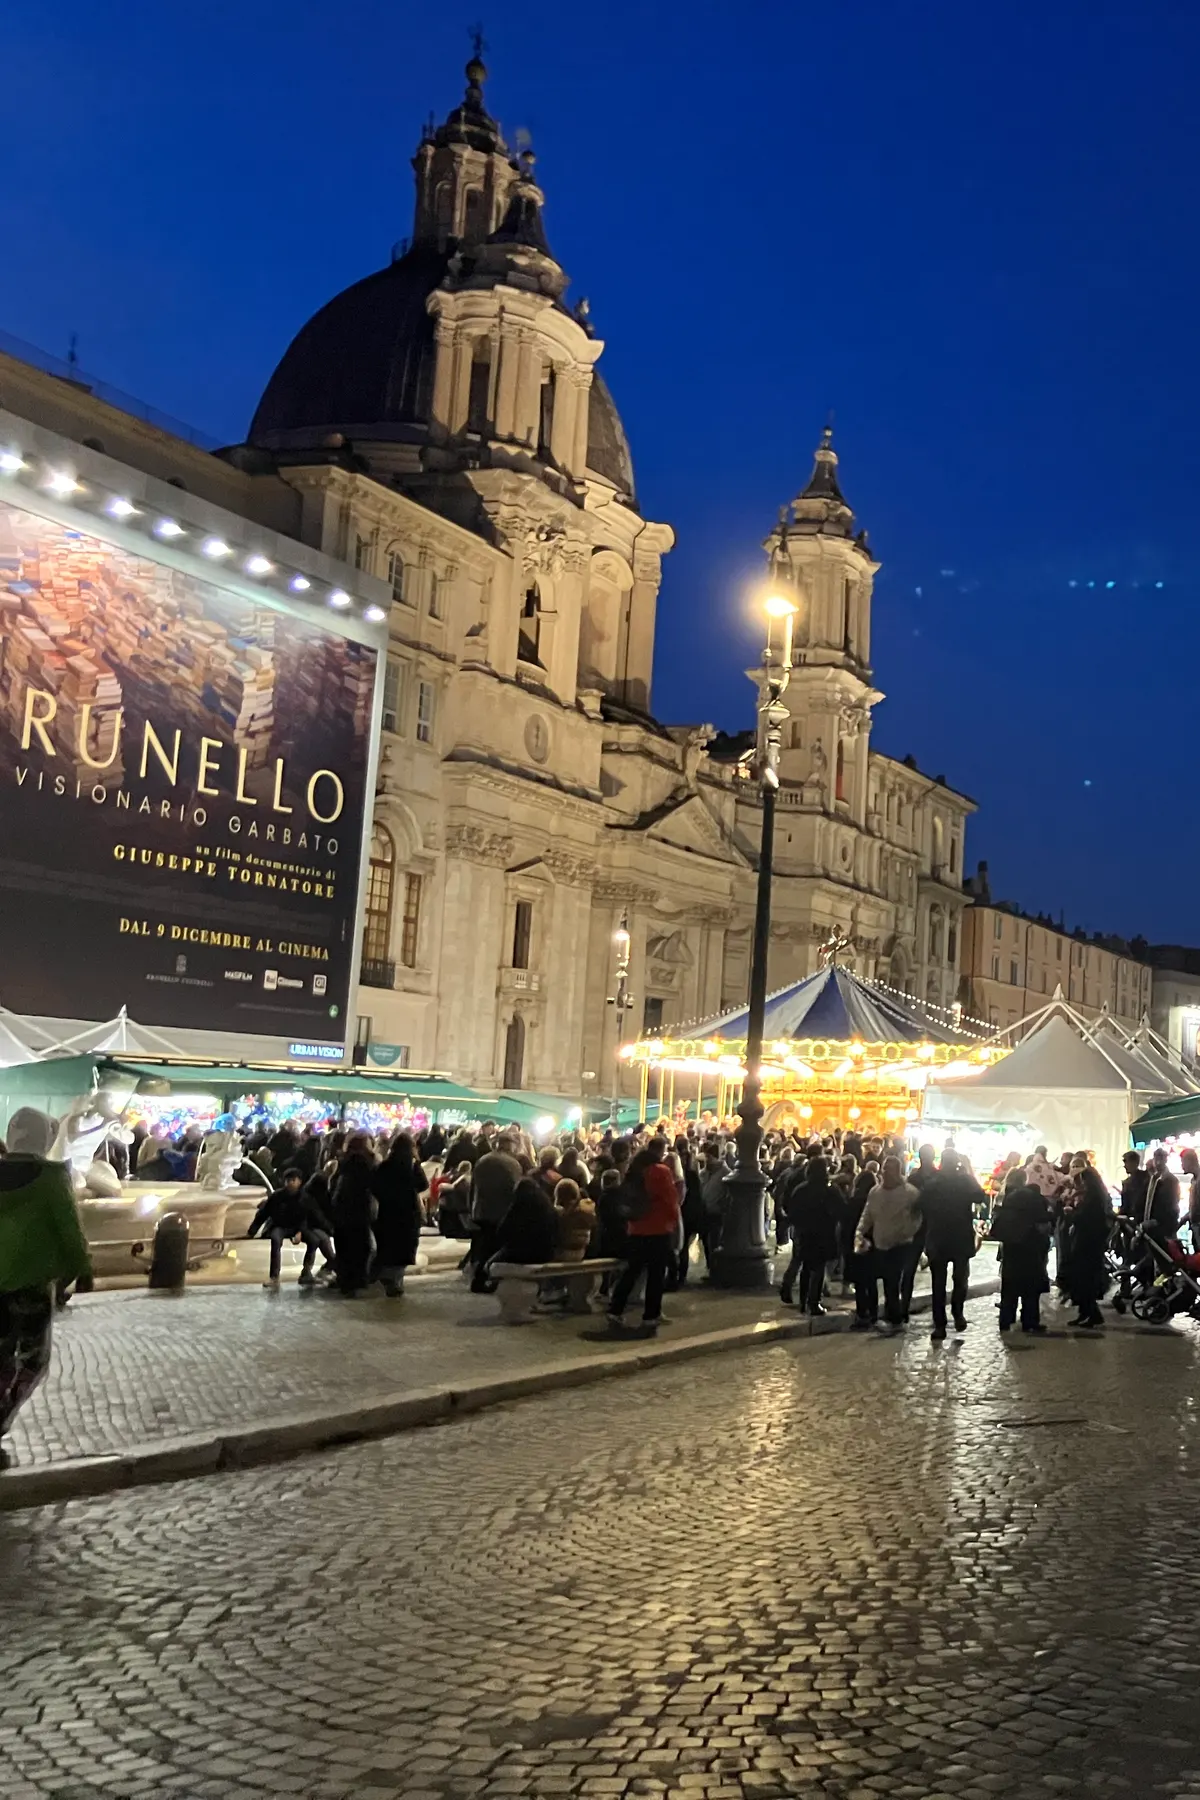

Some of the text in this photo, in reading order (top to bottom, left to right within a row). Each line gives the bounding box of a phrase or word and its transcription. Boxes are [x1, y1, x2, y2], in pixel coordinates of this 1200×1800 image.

[15, 765, 339, 855] VISIONARIO GARBATO
[113, 844, 335, 899] GIUSEPPE TORNATORE
[195, 845, 336, 881] un film documentario di
[119, 917, 330, 961] DAL 9 DICEMBRE AL CINEMA
[290, 1044, 344, 1059] URBAN VISION
